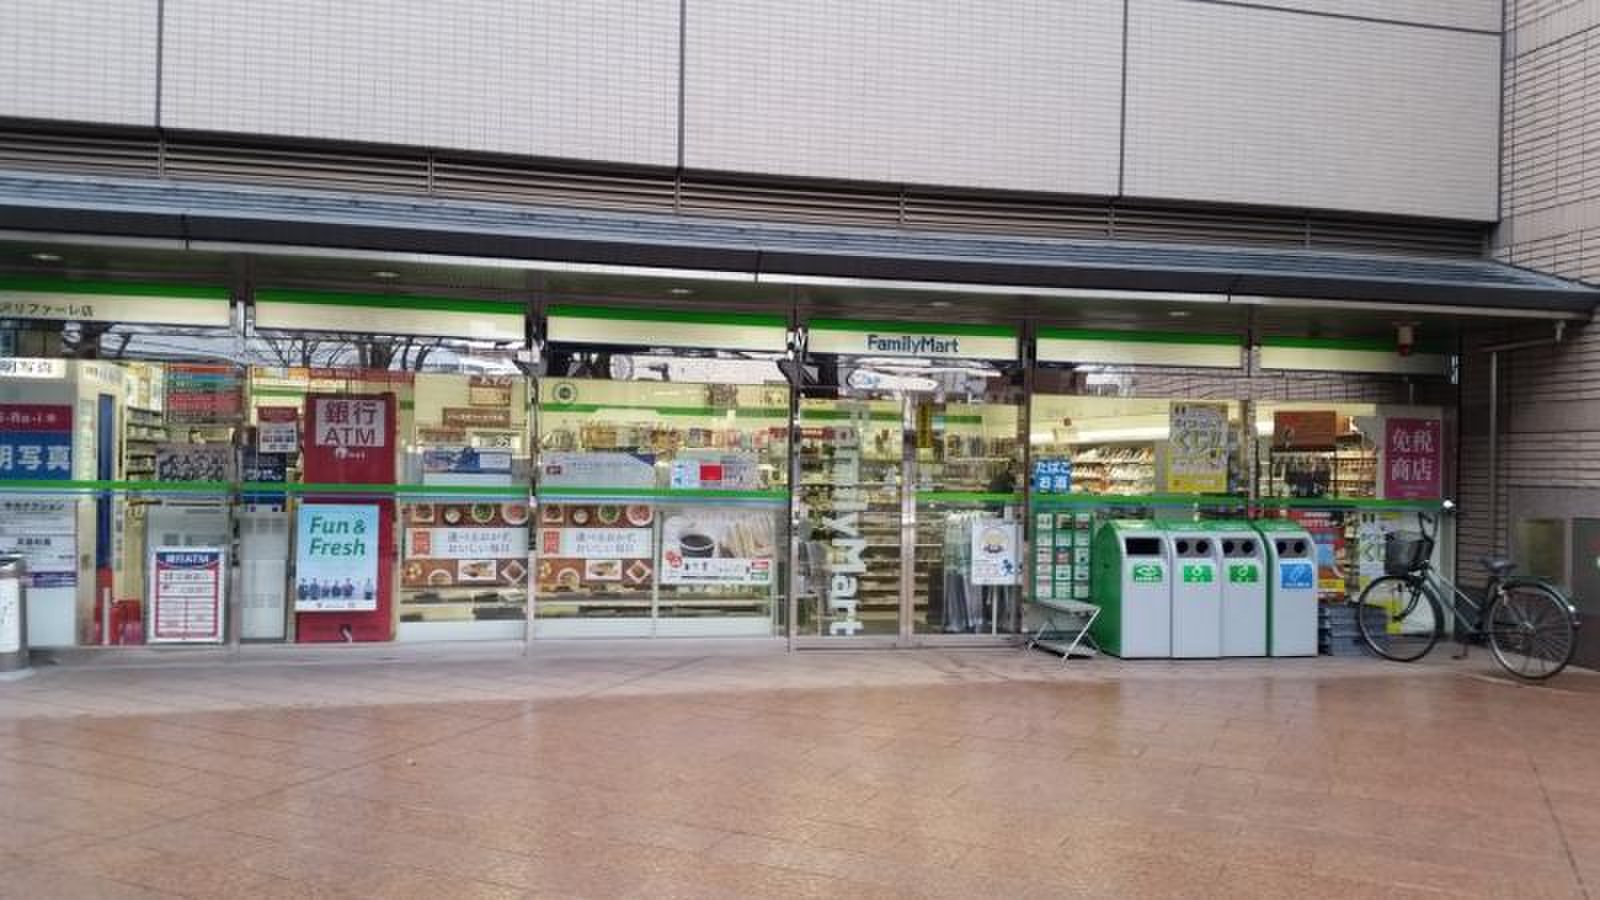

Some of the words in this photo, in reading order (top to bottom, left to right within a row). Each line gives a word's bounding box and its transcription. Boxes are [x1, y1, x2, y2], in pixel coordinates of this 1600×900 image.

[866, 335, 959, 356] FamilyMart
[325, 401, 377, 425] 銀行
[325, 427, 376, 445] ATM
[1392, 428, 1435, 453] 免税
[1035, 461, 1070, 474] たばこ
[1391, 457, 1433, 481] 商店
[310, 516, 349, 535] Fun
[352, 519, 367, 535] &
[310, 538, 366, 556] Fresh
